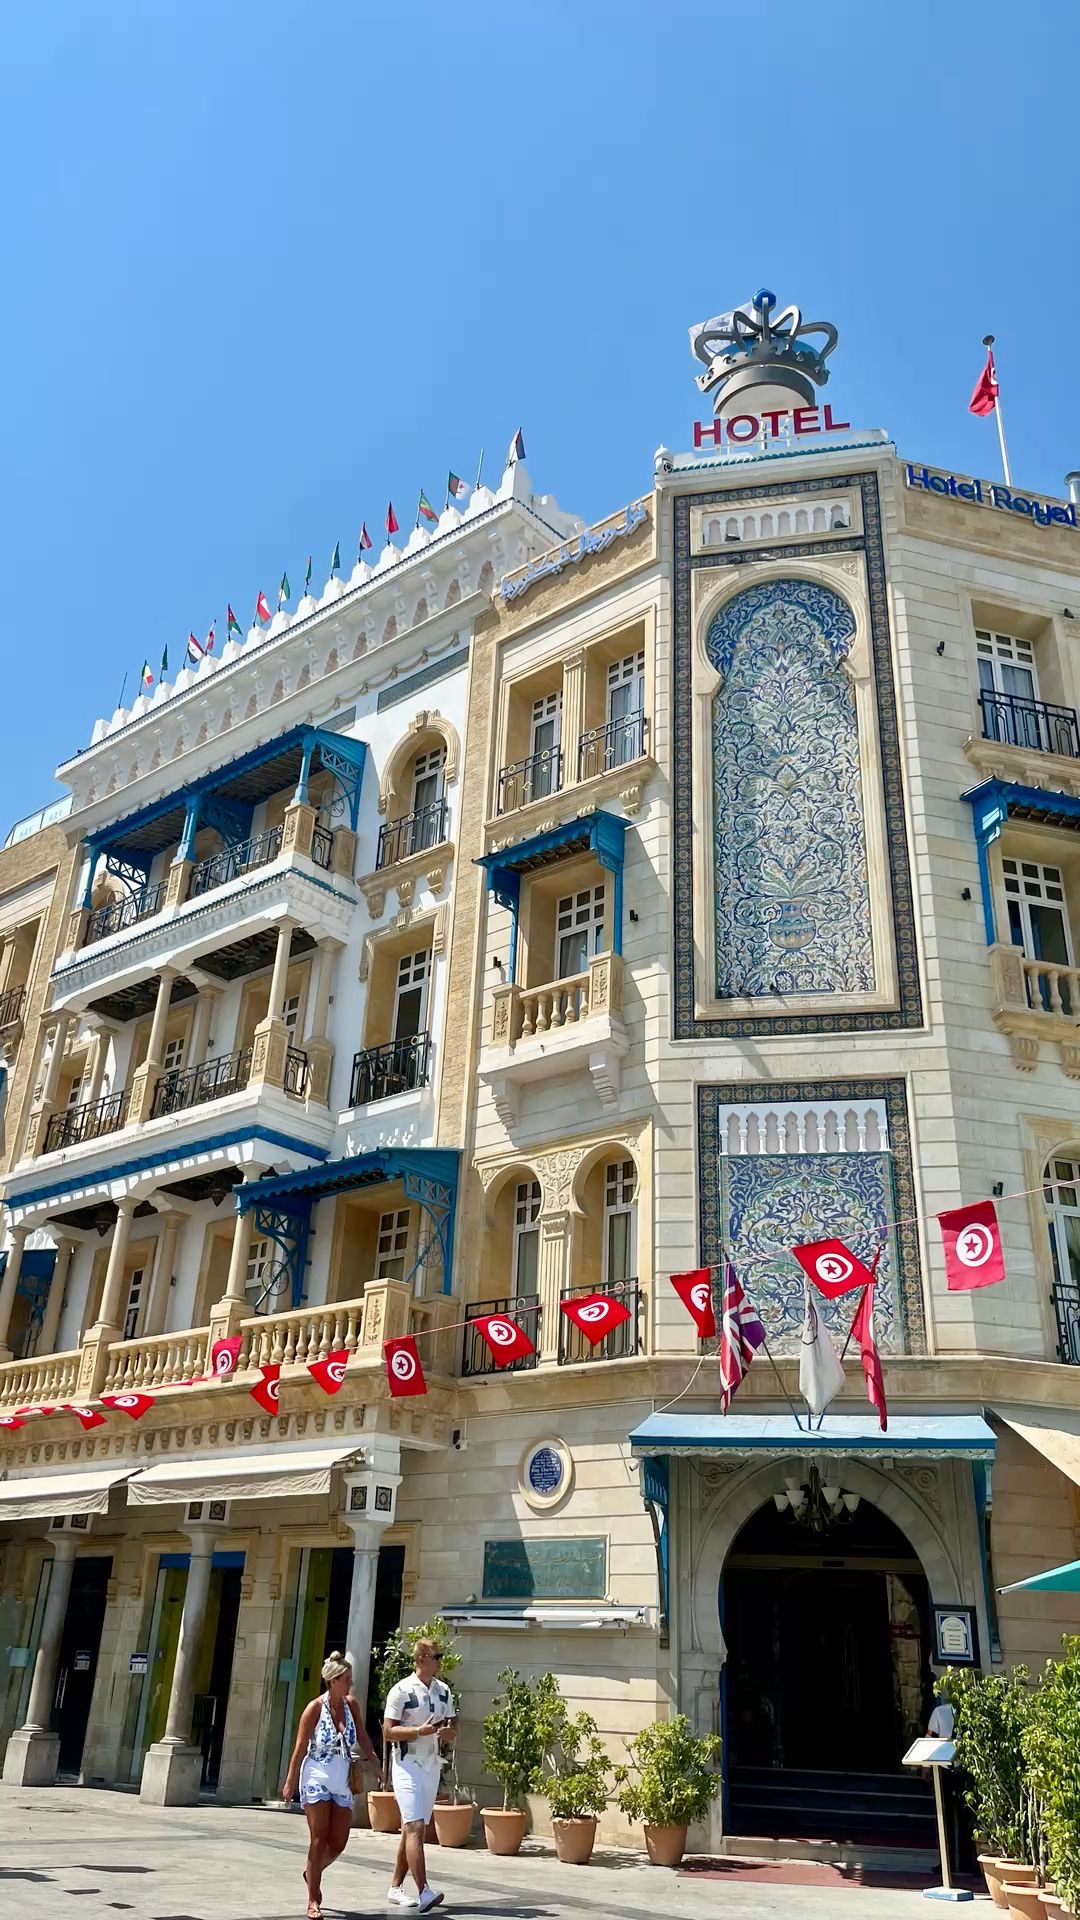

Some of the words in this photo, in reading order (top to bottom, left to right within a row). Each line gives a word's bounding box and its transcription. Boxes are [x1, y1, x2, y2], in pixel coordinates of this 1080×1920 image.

[693, 404, 850, 448] HOTEL
[905, 463, 984, 504] Hotel
[988, 484, 1077, 529] Royal
